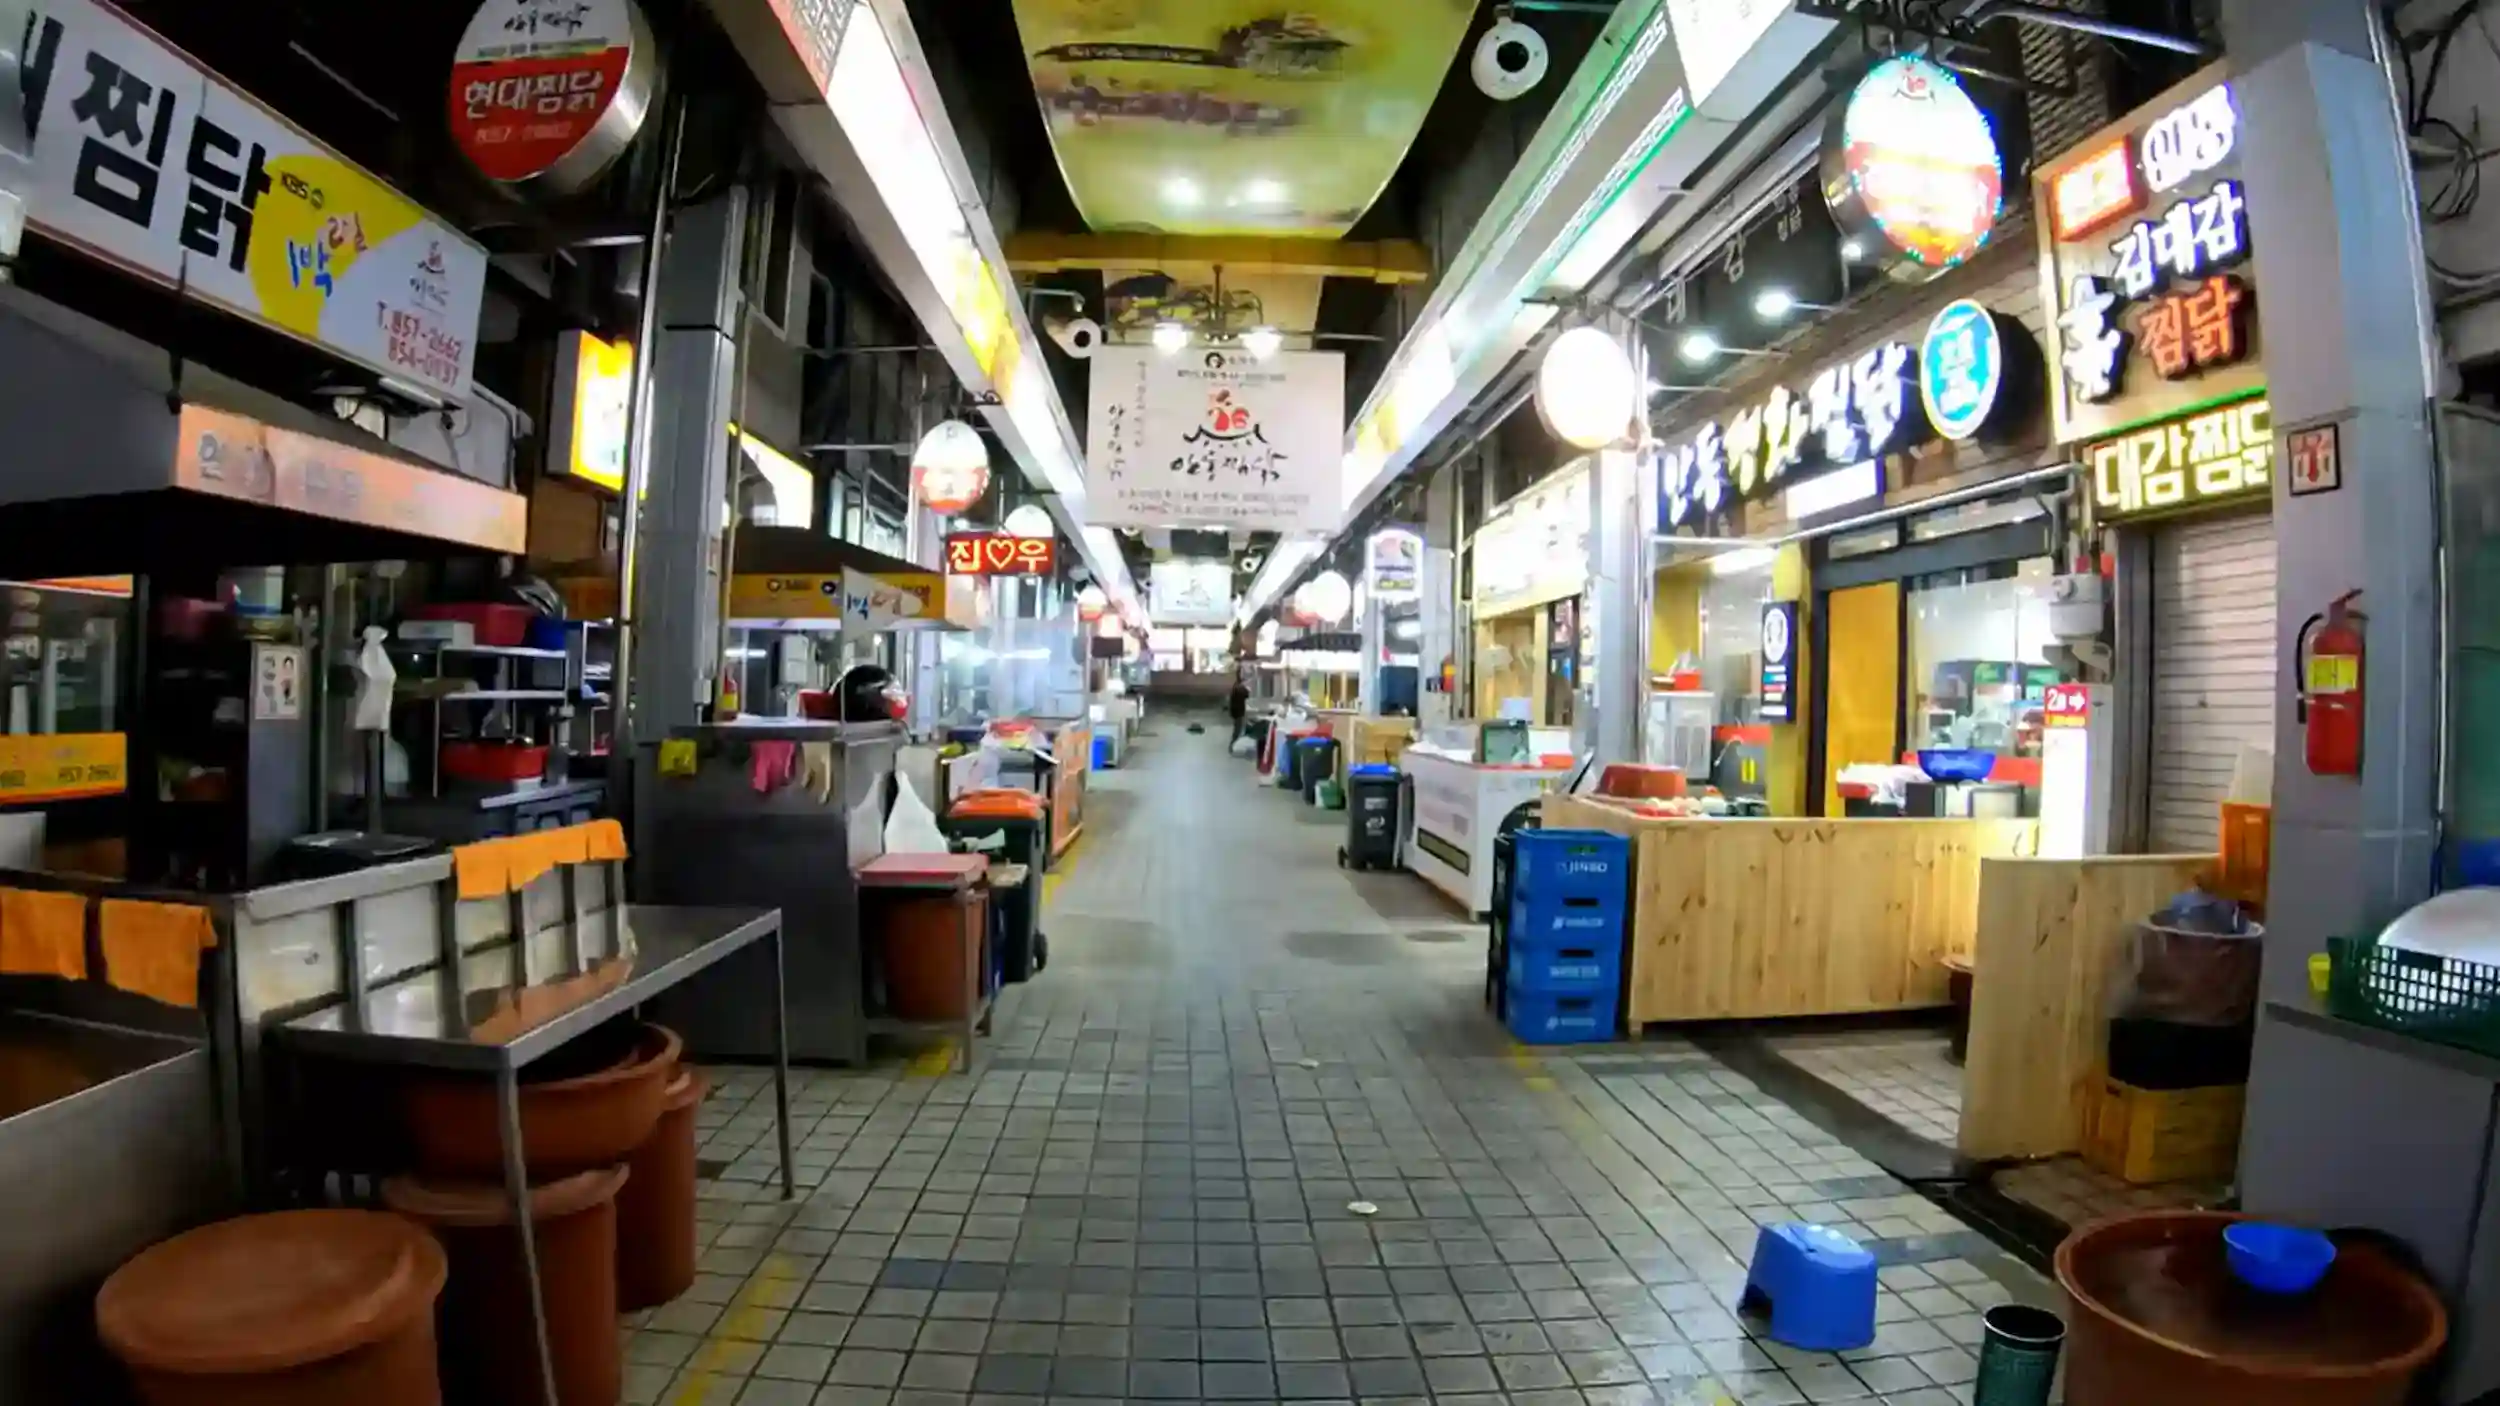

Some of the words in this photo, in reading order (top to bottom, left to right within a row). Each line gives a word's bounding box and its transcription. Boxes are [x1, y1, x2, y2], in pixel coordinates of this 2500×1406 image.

[465, 71, 604, 119] 현대찜닭
[2109, 180, 2244, 299] 김대감
[2138, 274, 2242, 380] 찜닭
